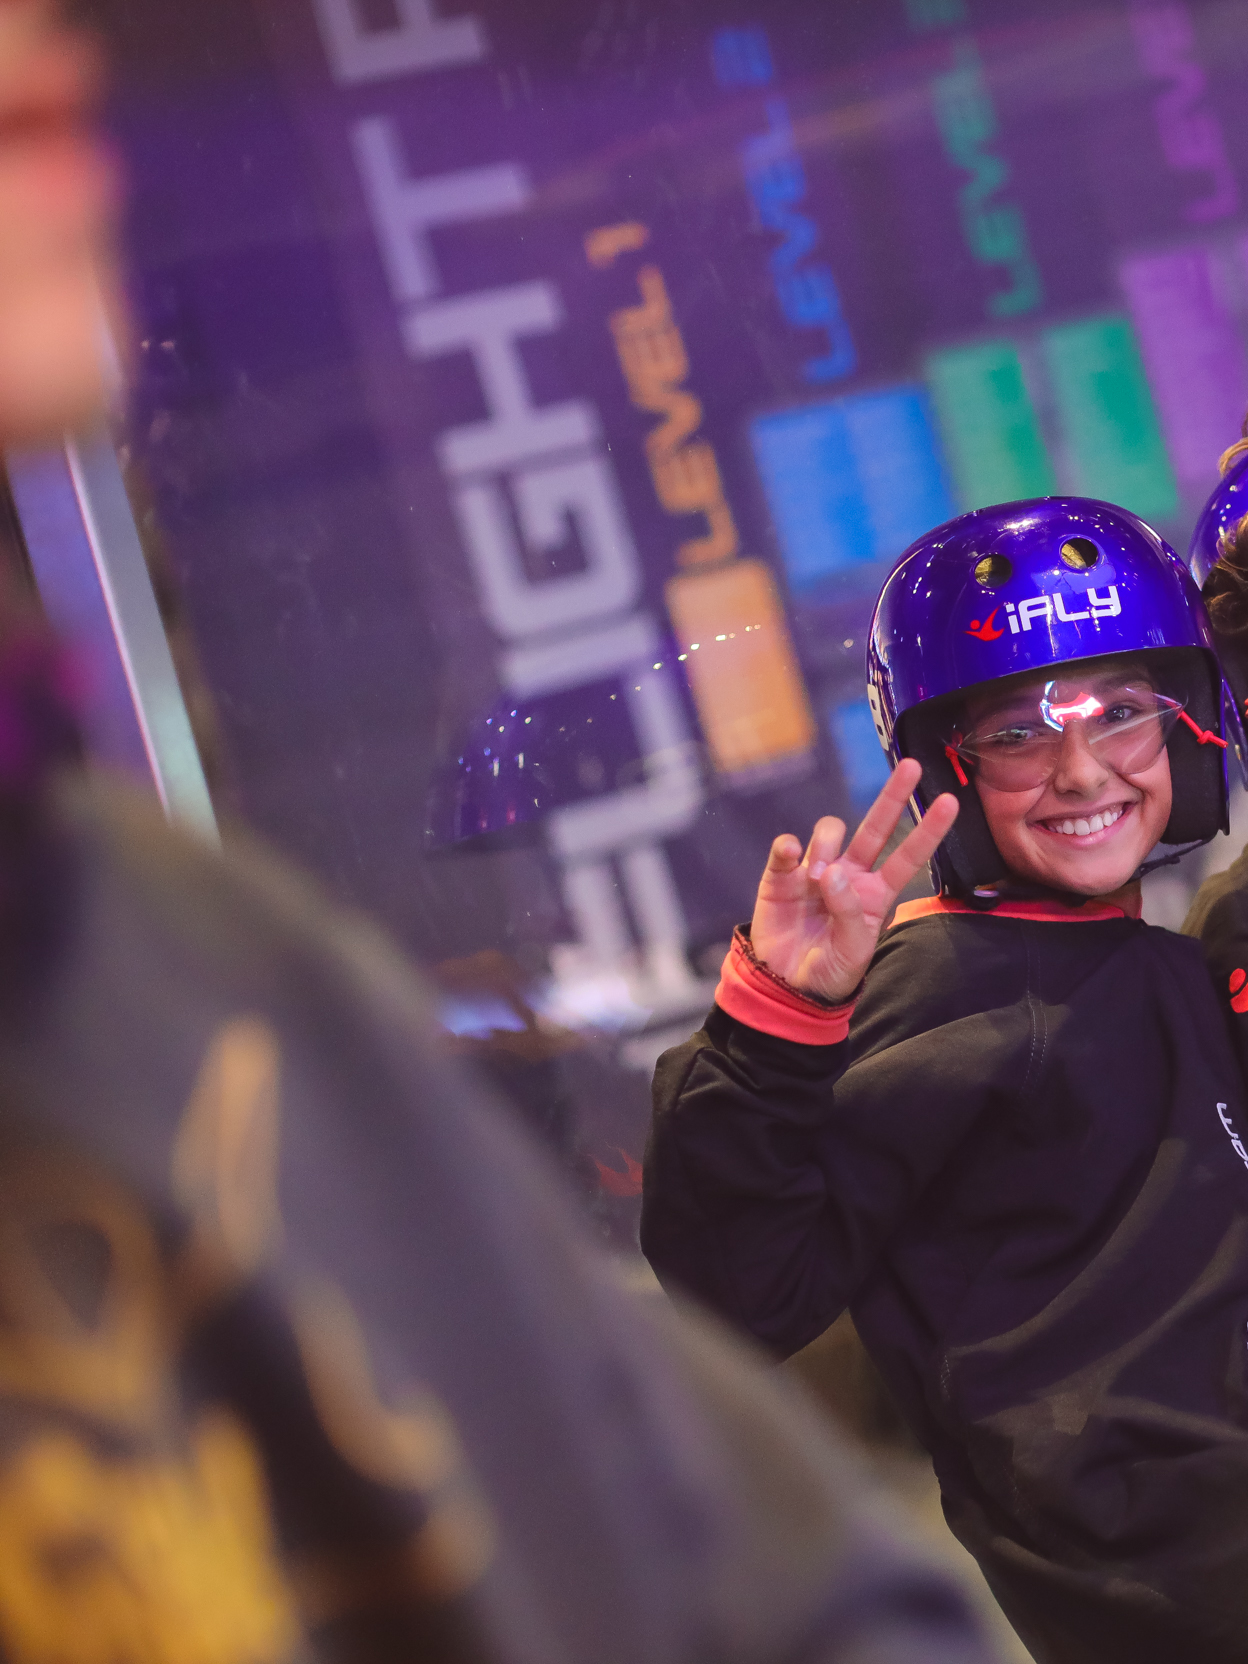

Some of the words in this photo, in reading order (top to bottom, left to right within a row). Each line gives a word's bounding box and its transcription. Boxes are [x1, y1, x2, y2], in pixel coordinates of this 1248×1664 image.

[740, 95, 858, 382] LEVEL
[932, 40, 1044, 316] LEVEL
[608, 266, 738, 562] LEVEL
[1006, 586, 1122, 634] iFLY
